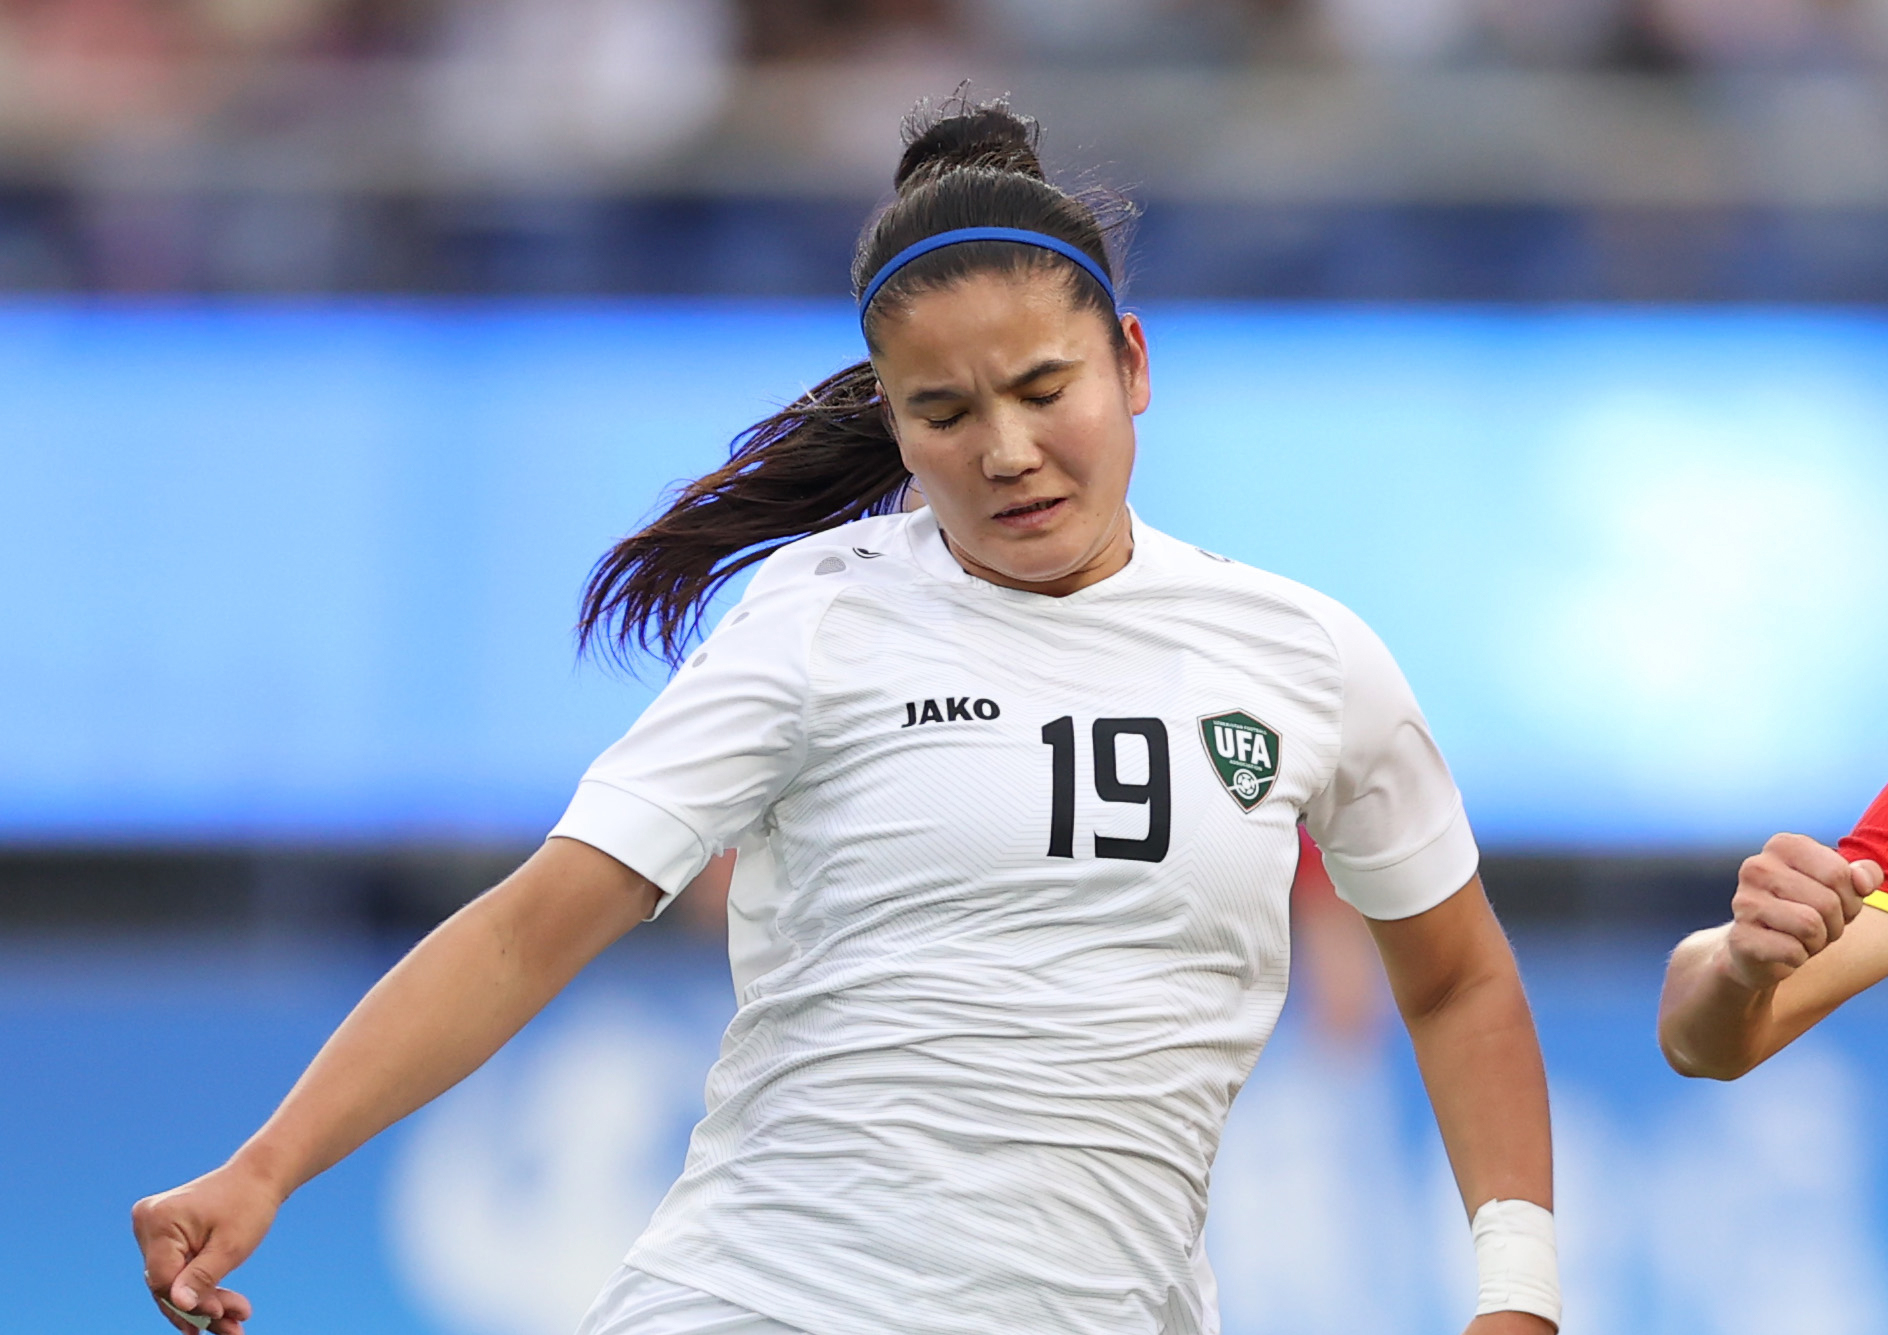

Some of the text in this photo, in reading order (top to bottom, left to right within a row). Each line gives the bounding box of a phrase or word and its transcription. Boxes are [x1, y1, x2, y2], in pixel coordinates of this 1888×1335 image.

[901, 697, 1000, 728] JAKO
[1213, 725, 1271, 769] UFA
[1041, 715, 1171, 863] 19
